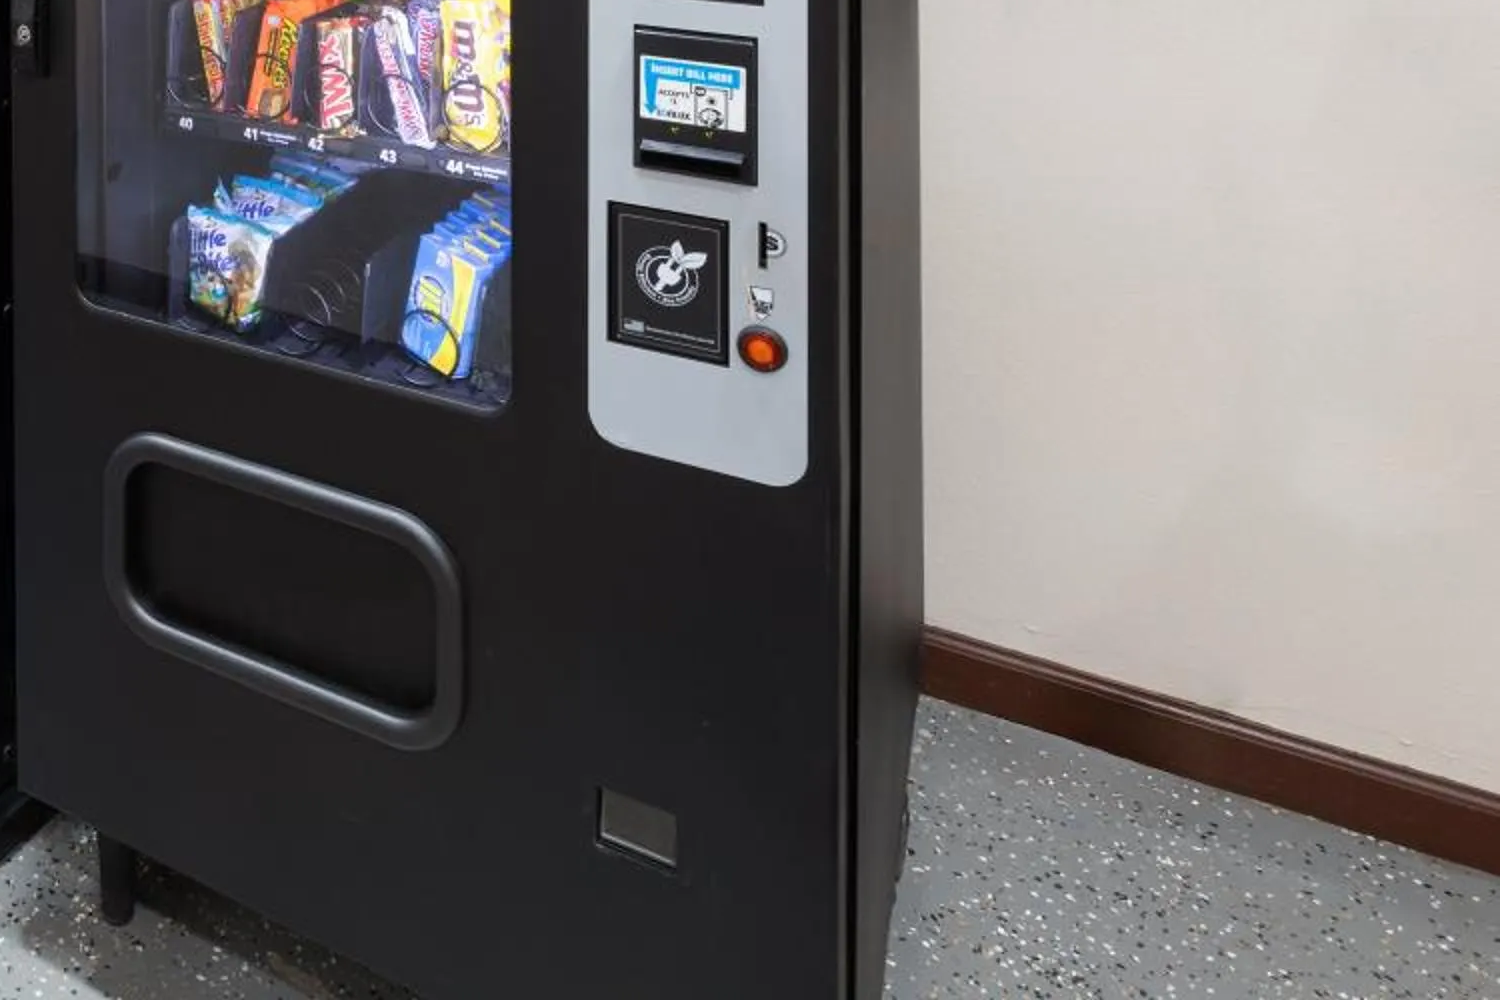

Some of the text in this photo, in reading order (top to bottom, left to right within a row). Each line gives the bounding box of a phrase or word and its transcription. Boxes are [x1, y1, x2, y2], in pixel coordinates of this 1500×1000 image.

[179, 116, 194, 131] 40
[243, 127, 259, 141] 41
[307, 137, 326, 152] 42
[379, 148, 397, 164] 43
[445, 159, 465, 175] 44
